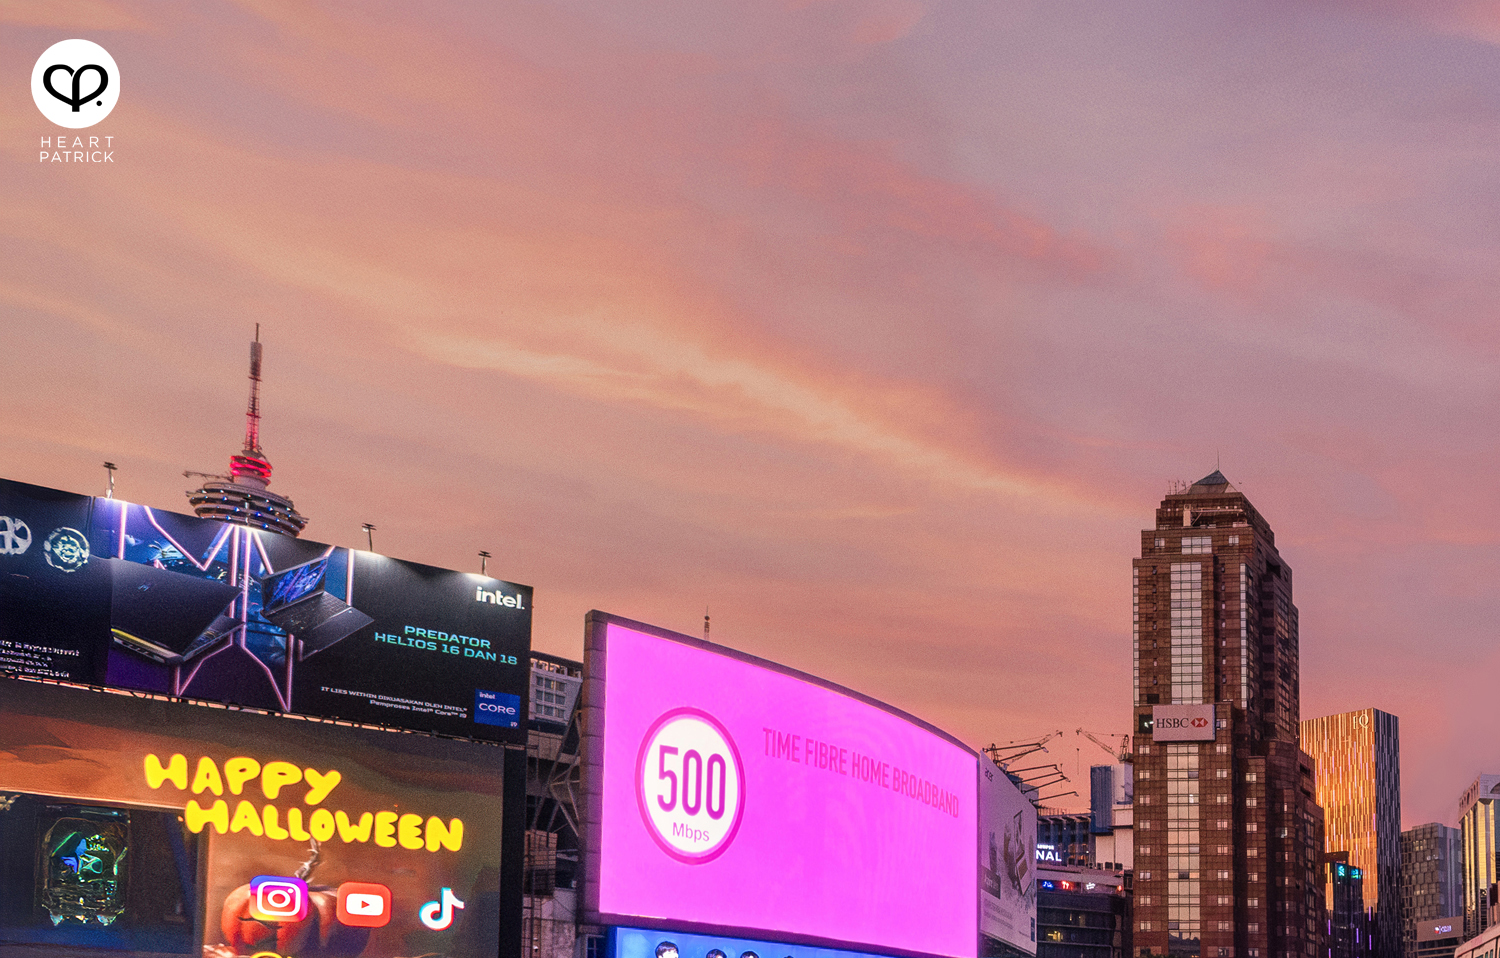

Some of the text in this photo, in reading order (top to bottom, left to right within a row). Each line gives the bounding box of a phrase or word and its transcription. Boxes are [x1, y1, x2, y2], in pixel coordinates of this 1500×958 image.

[374, 631, 518, 665] HELIOS 16 DAN 18
[404, 625, 491, 649] PREDATOR
[479, 691, 496, 700] intel
[1156, 718, 1189, 728] HSBC
[144, 753, 343, 806] HAPPY
[656, 744, 727, 821] 500
[762, 727, 960, 819] TIME FIBRE HOME BROADBAND
[184, 799, 465, 852] HALLOWEEN
[672, 821, 711, 844] Mbps
